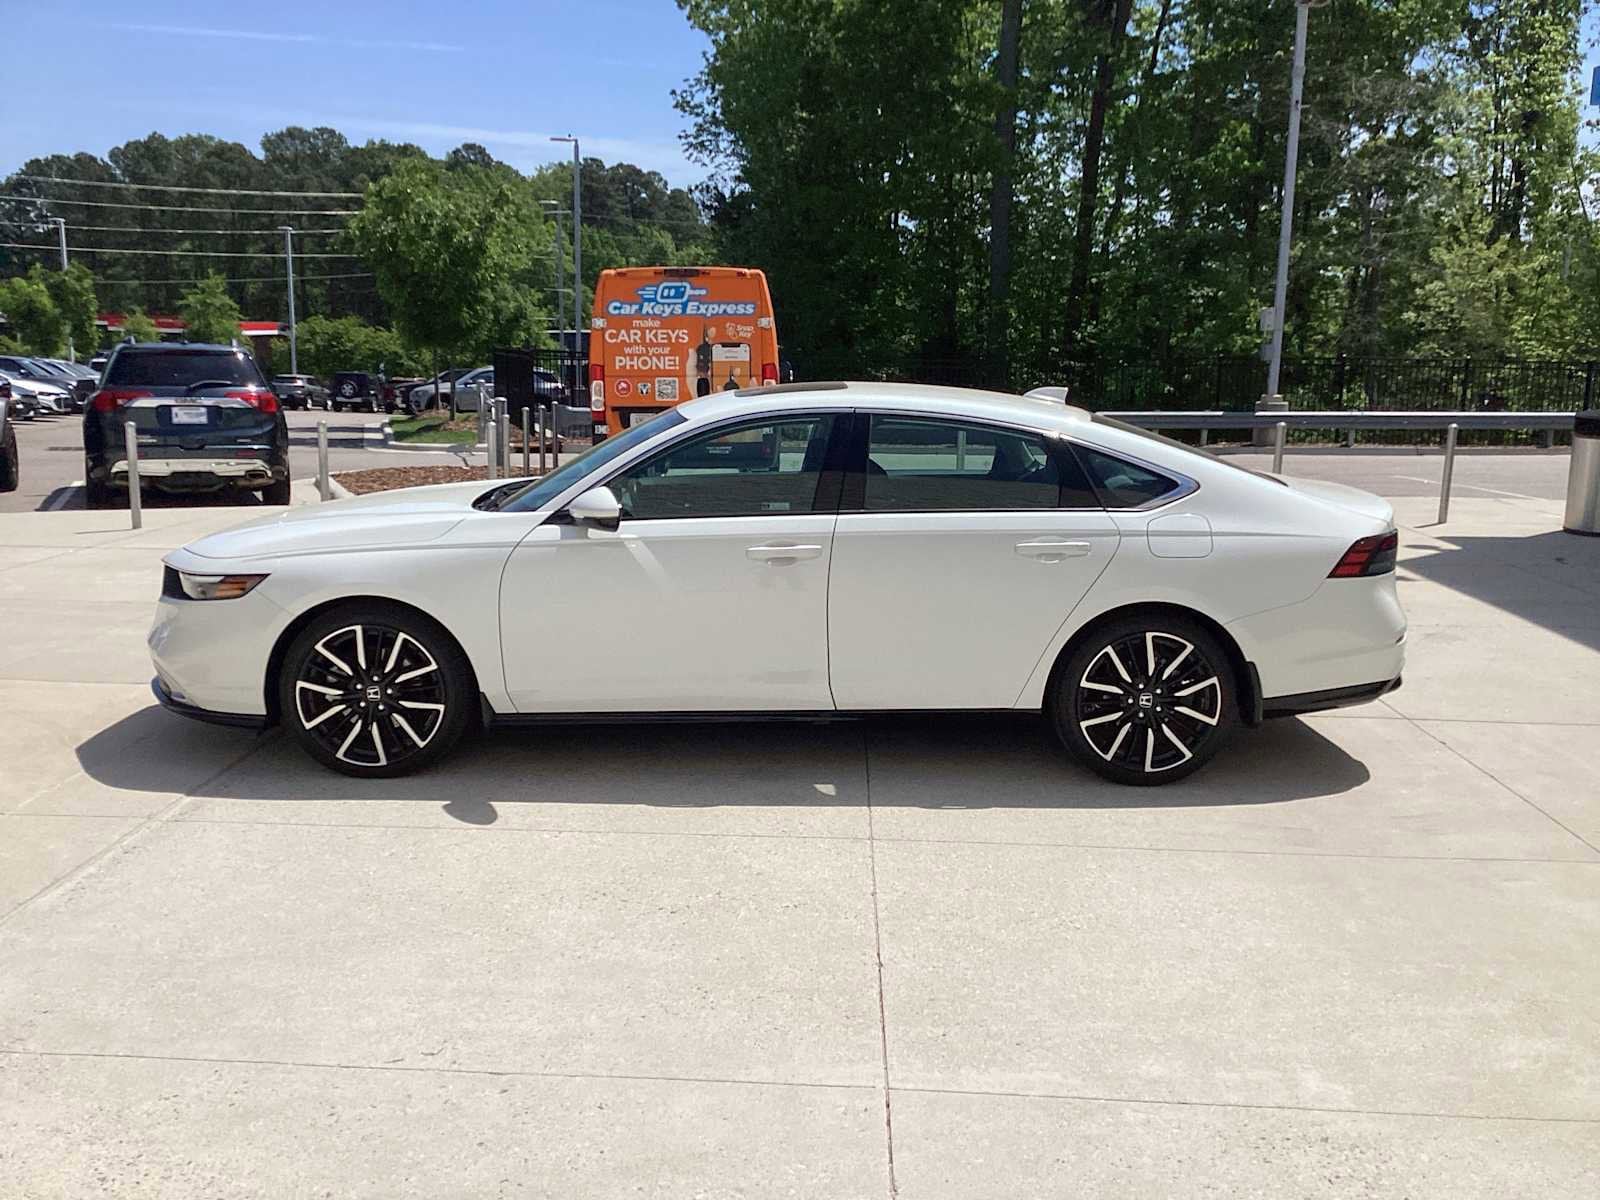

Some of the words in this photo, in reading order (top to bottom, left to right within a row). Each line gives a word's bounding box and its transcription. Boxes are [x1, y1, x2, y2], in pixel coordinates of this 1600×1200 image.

[608, 302, 640, 315] Car
[641, 302, 682, 316] Keys
[686, 302, 755, 317] Express
[632, 318, 661, 328] make
[605, 330, 643, 343] CAR
[645, 329, 689, 343] KEYS
[624, 344, 646, 355] with
[647, 346, 670, 356] your
[615, 356, 680, 370] PHONE!
